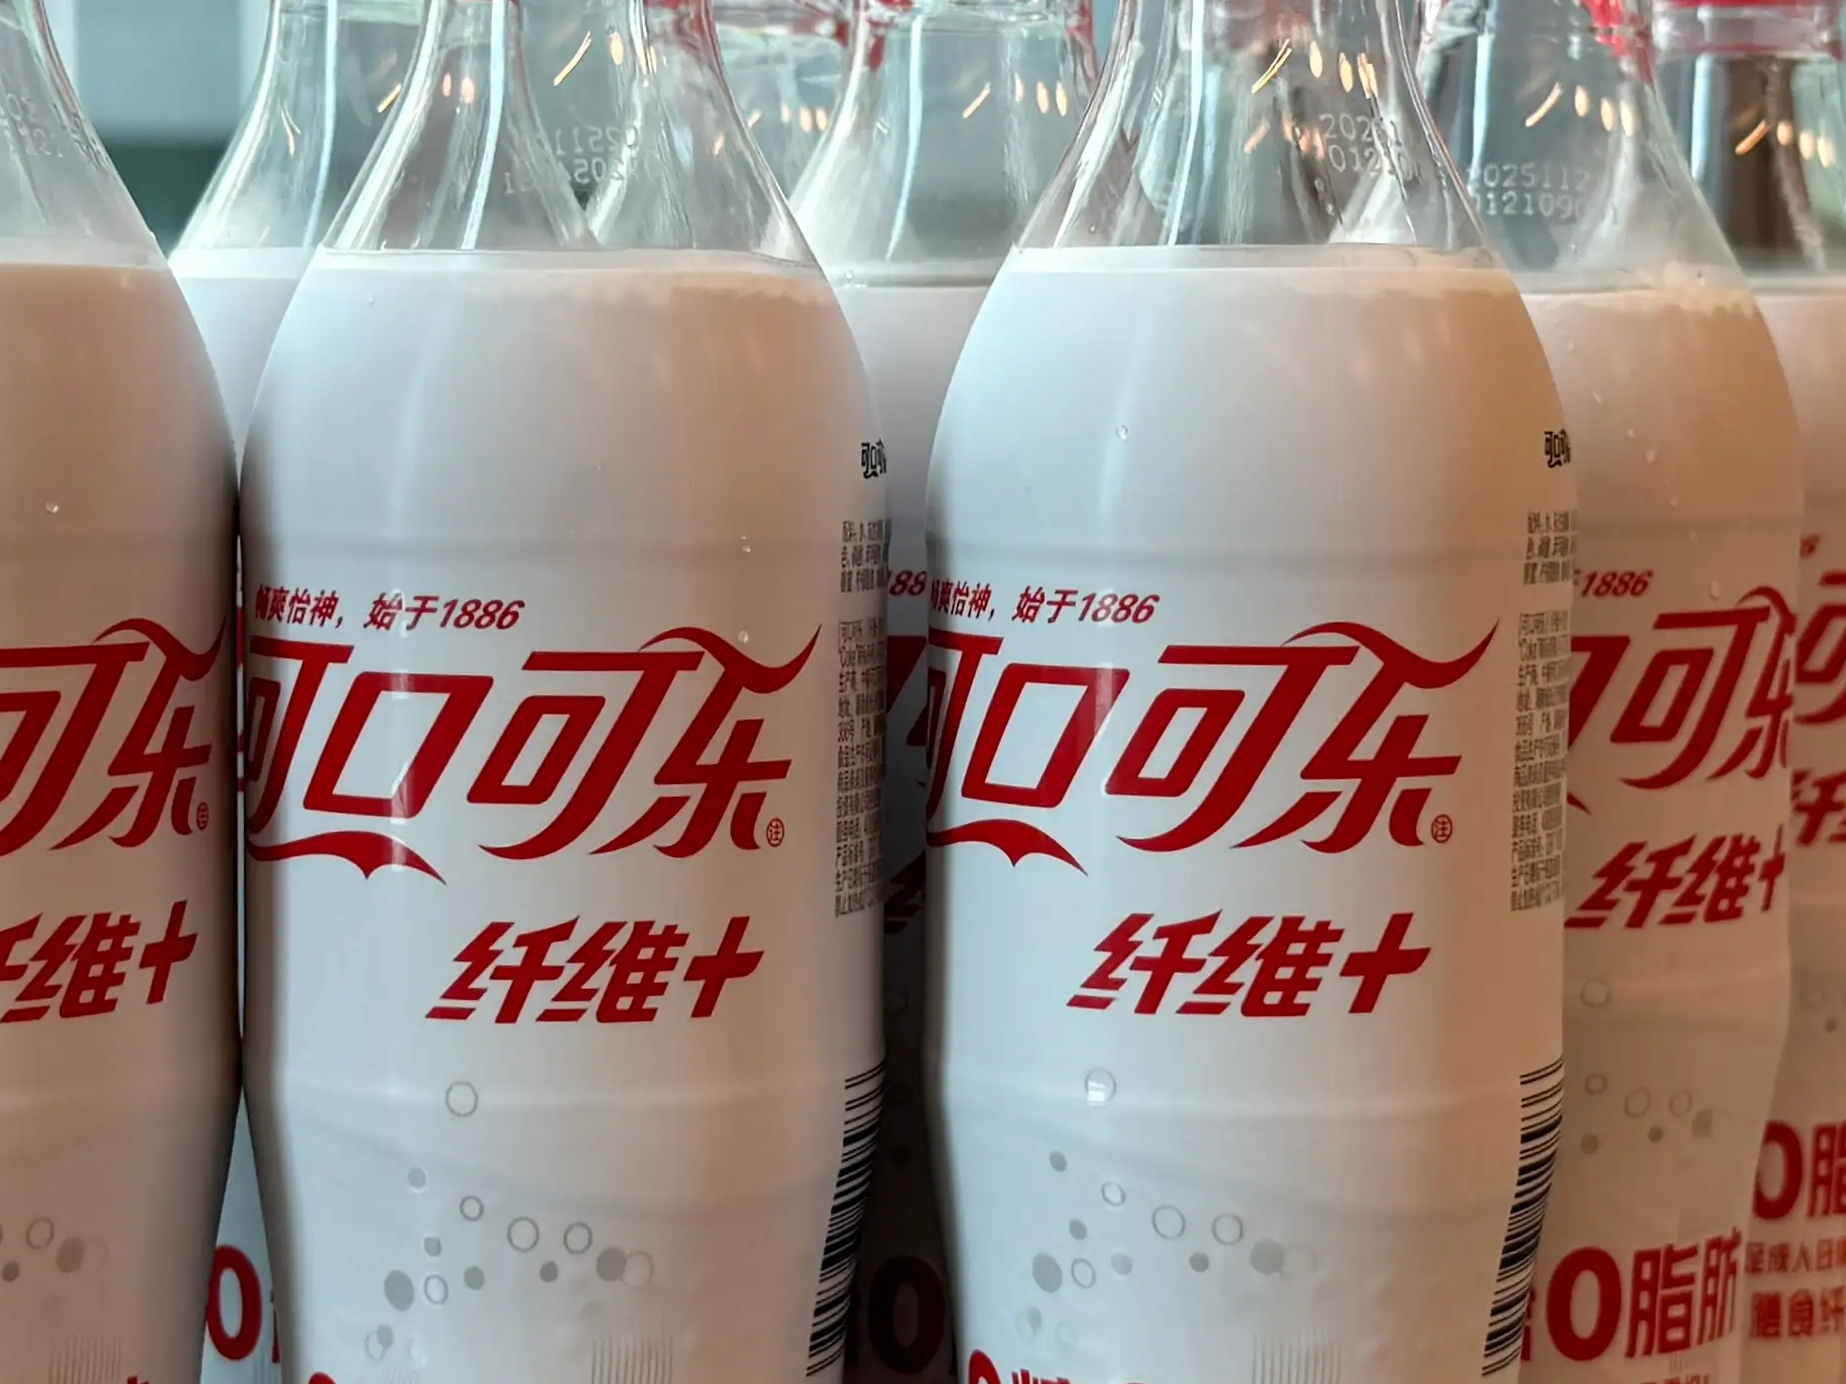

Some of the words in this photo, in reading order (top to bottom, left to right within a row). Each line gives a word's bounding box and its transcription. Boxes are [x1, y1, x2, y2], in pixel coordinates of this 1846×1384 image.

[246, 624, 822, 886] 可口可乐
[424, 914, 766, 1025] 纤维+
[1065, 907, 1433, 1019] 纤维+
